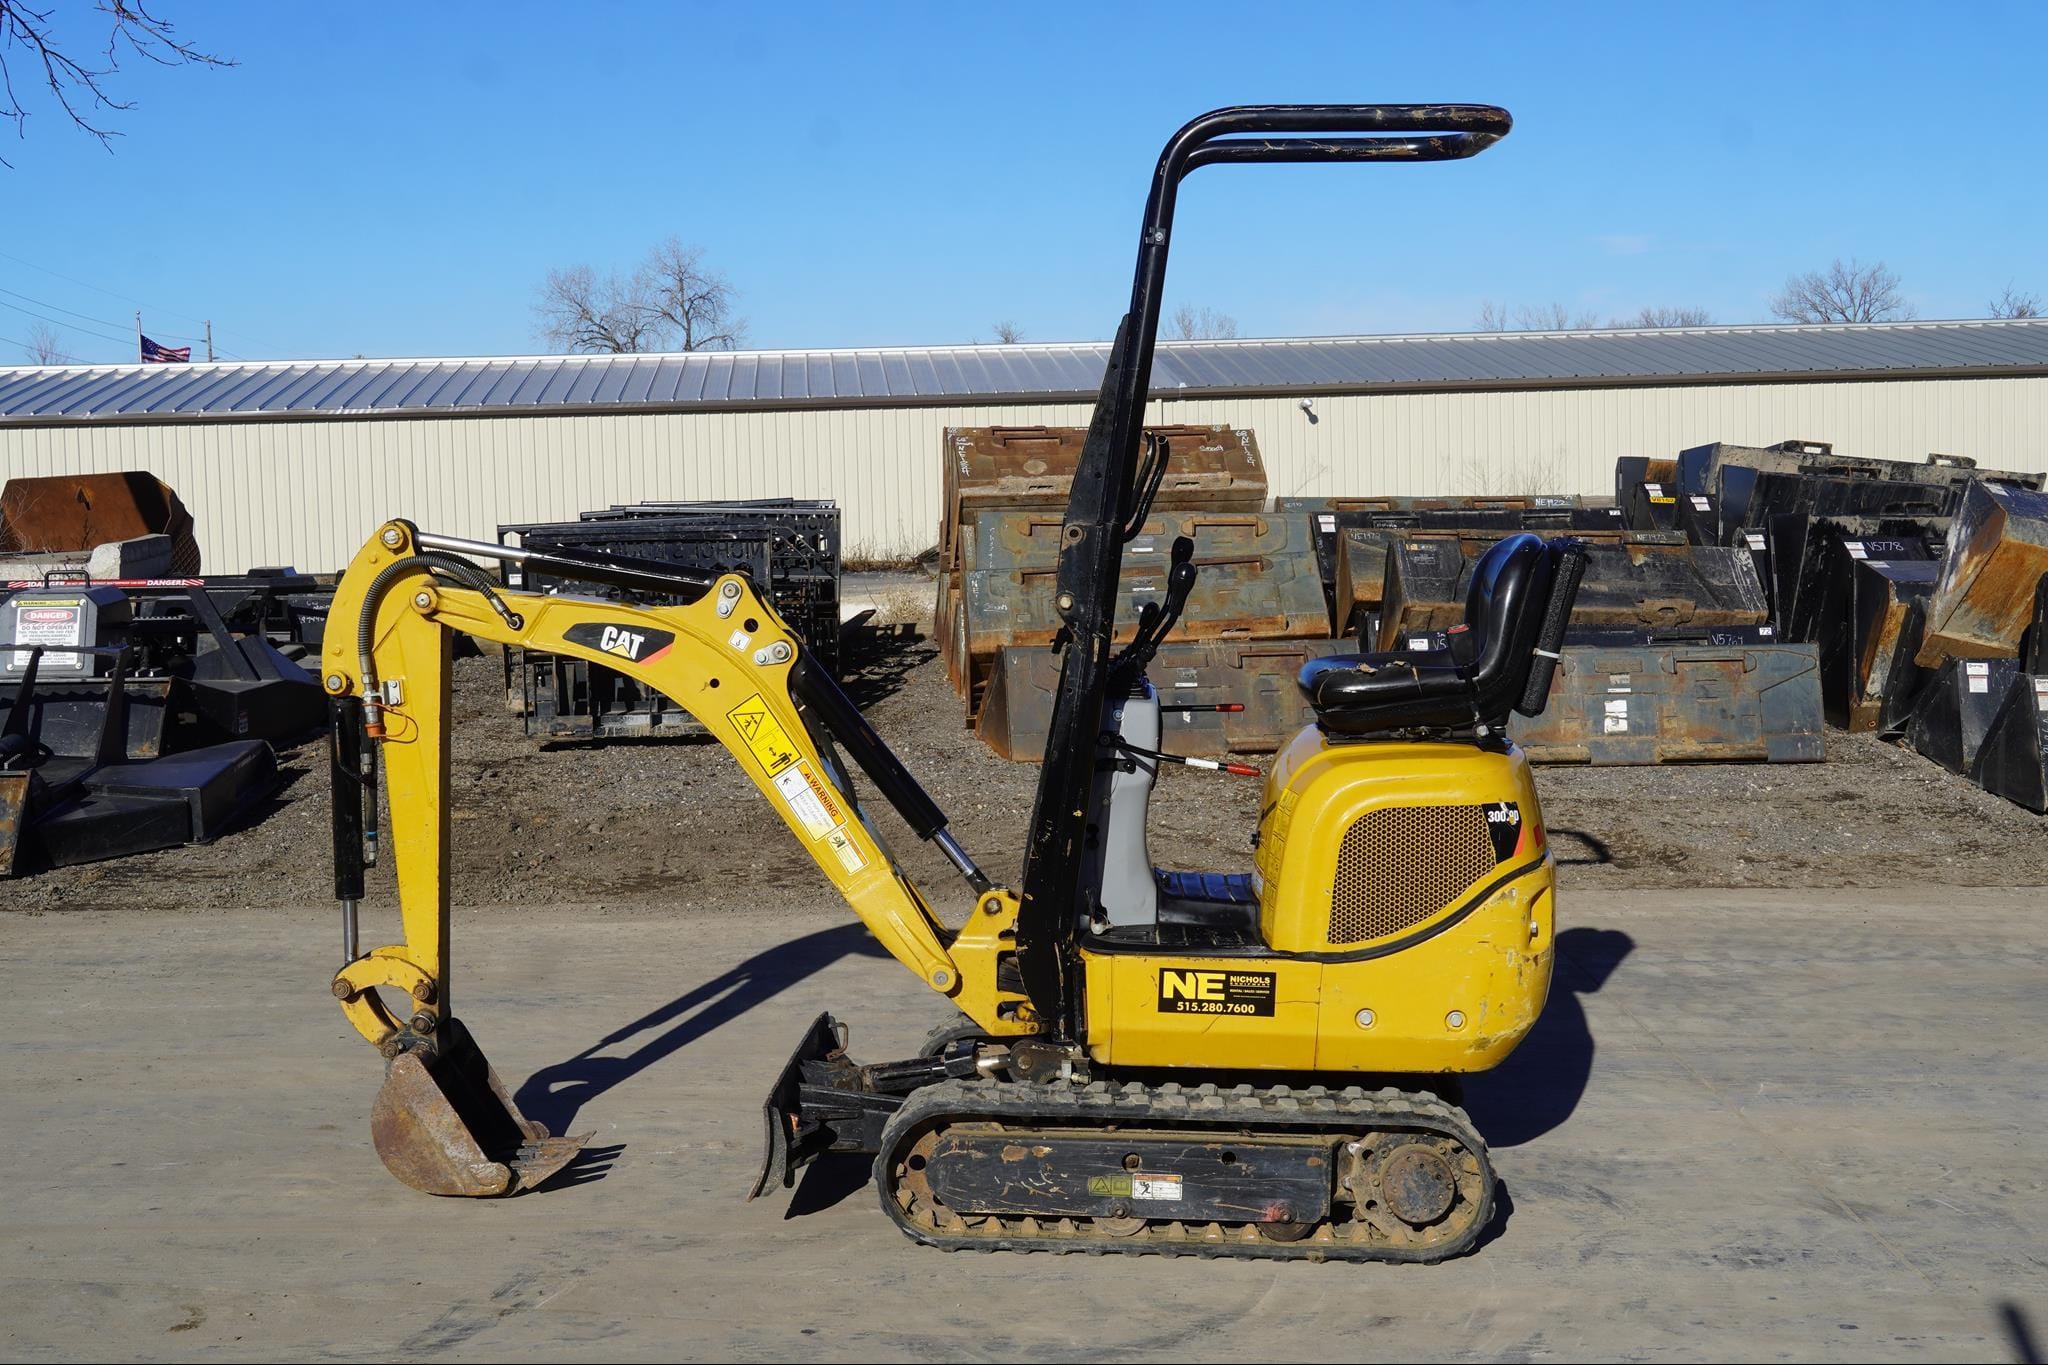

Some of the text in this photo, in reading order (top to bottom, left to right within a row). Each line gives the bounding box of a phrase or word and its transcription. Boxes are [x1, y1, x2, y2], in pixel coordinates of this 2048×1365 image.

[31, 611, 68, 619] DANGER
[600, 626, 645, 660] CAT
[809, 778, 839, 816] WARNING
[1163, 971, 1226, 1001] NE
[1230, 976, 1270, 984] NICHOLS
[1177, 1001, 1256, 1014] 515.280.7600
